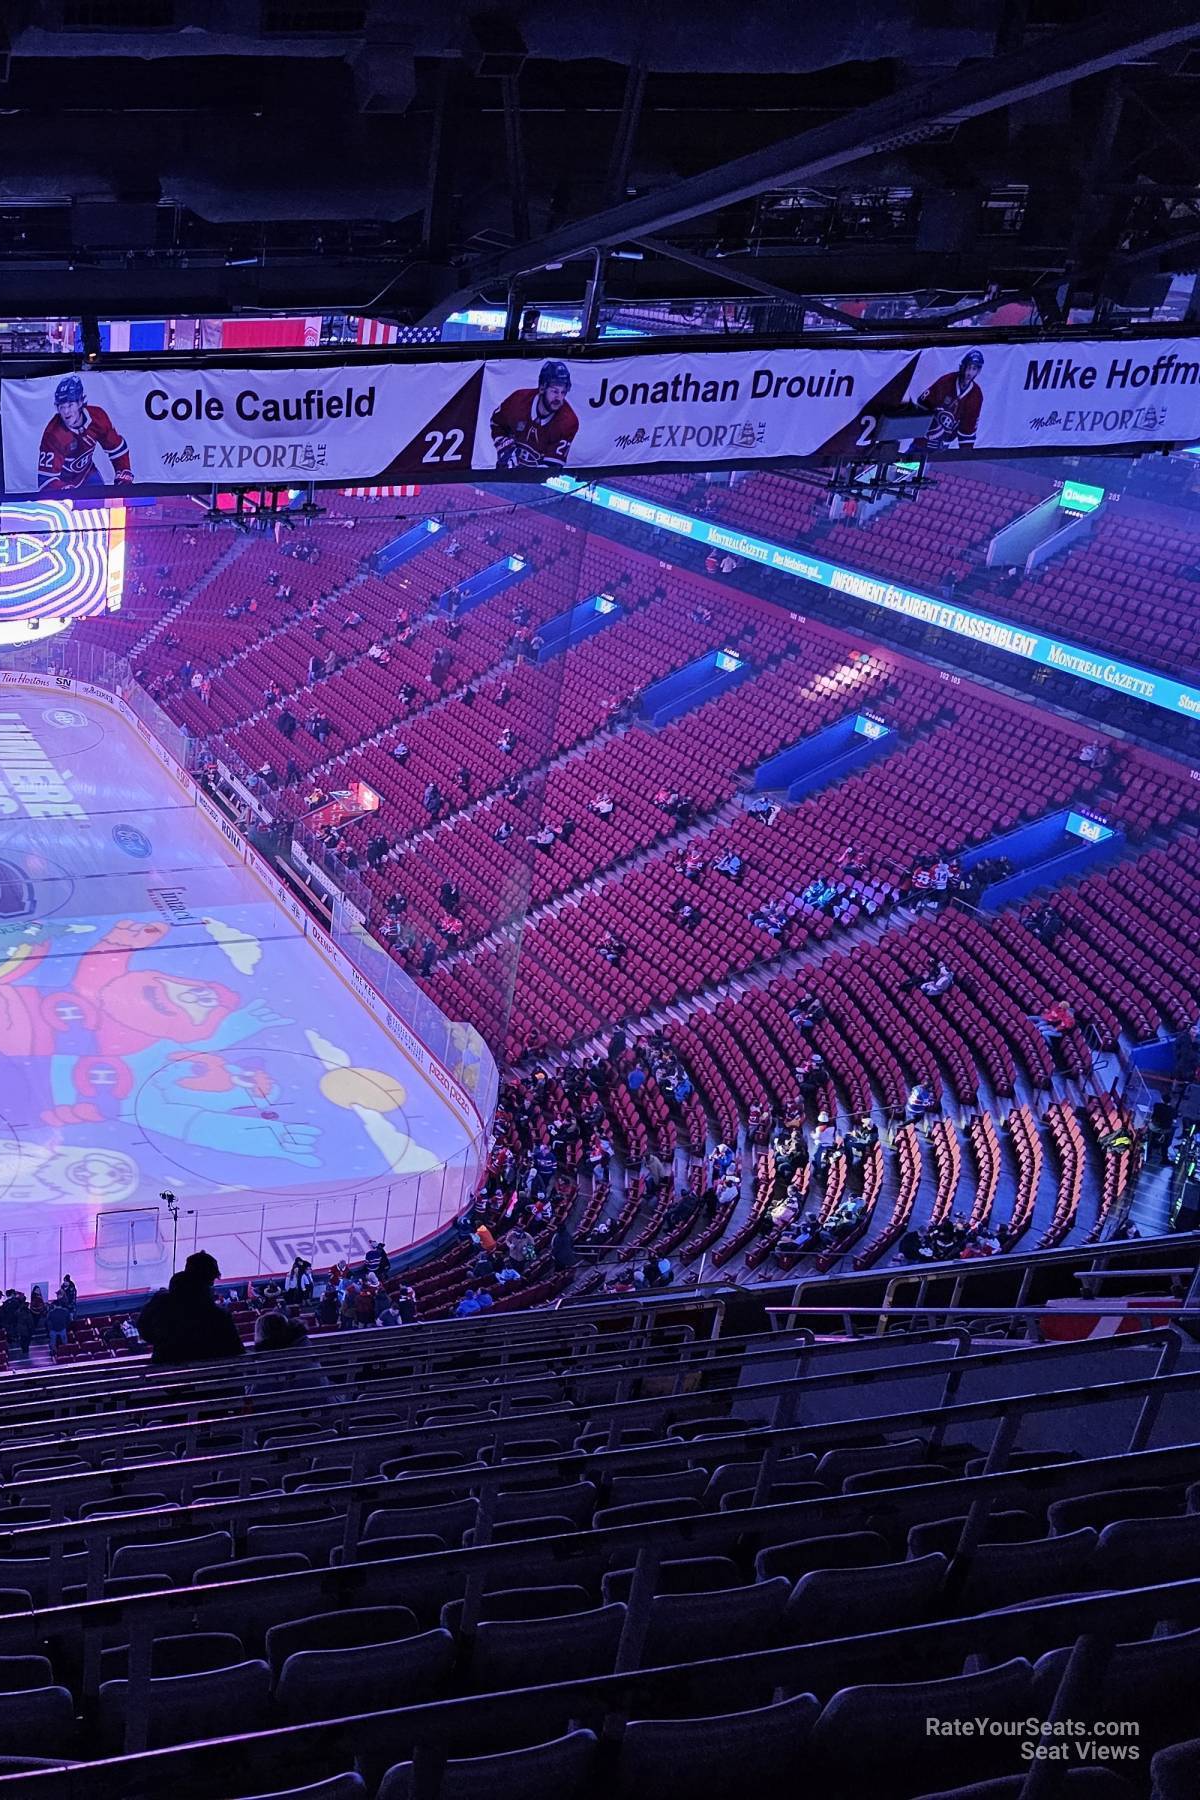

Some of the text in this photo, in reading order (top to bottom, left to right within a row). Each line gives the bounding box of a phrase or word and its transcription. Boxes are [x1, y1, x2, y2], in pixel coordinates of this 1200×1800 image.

[1023, 353, 1200, 391] Mike Hoffm
[144, 387, 376, 422] Cole Caufield
[588, 369, 855, 409] Jonathan Drouin
[1062, 407, 1143, 432] EXPORT
[421, 428, 465, 463] 22
[650, 425, 742, 448] EXPORT
[40, 451, 54, 468] 22
[161, 443, 327, 469] Molson EXPORT ALE
[740, 539, 769, 561] GAZETTE
[830, 570, 1039, 657] INFORMENT ÉCLAIRENT ET RASSEMBLENT
[1, 672, 51, 688] Tim Hortons
[55, 677, 72, 687] SN
[939, 671, 950, 681] 102
[1046, 644, 1156, 698] MONTREAL GAZETTE
[221, 821, 242, 852] RONA
[1079, 820, 1100, 840] Bell
[352, 968, 363, 985] THE
[364, 985, 376, 1001] KEG
[429, 1062, 470, 1115] pizza pizza
[283, 1234, 371, 1266] Fuel
